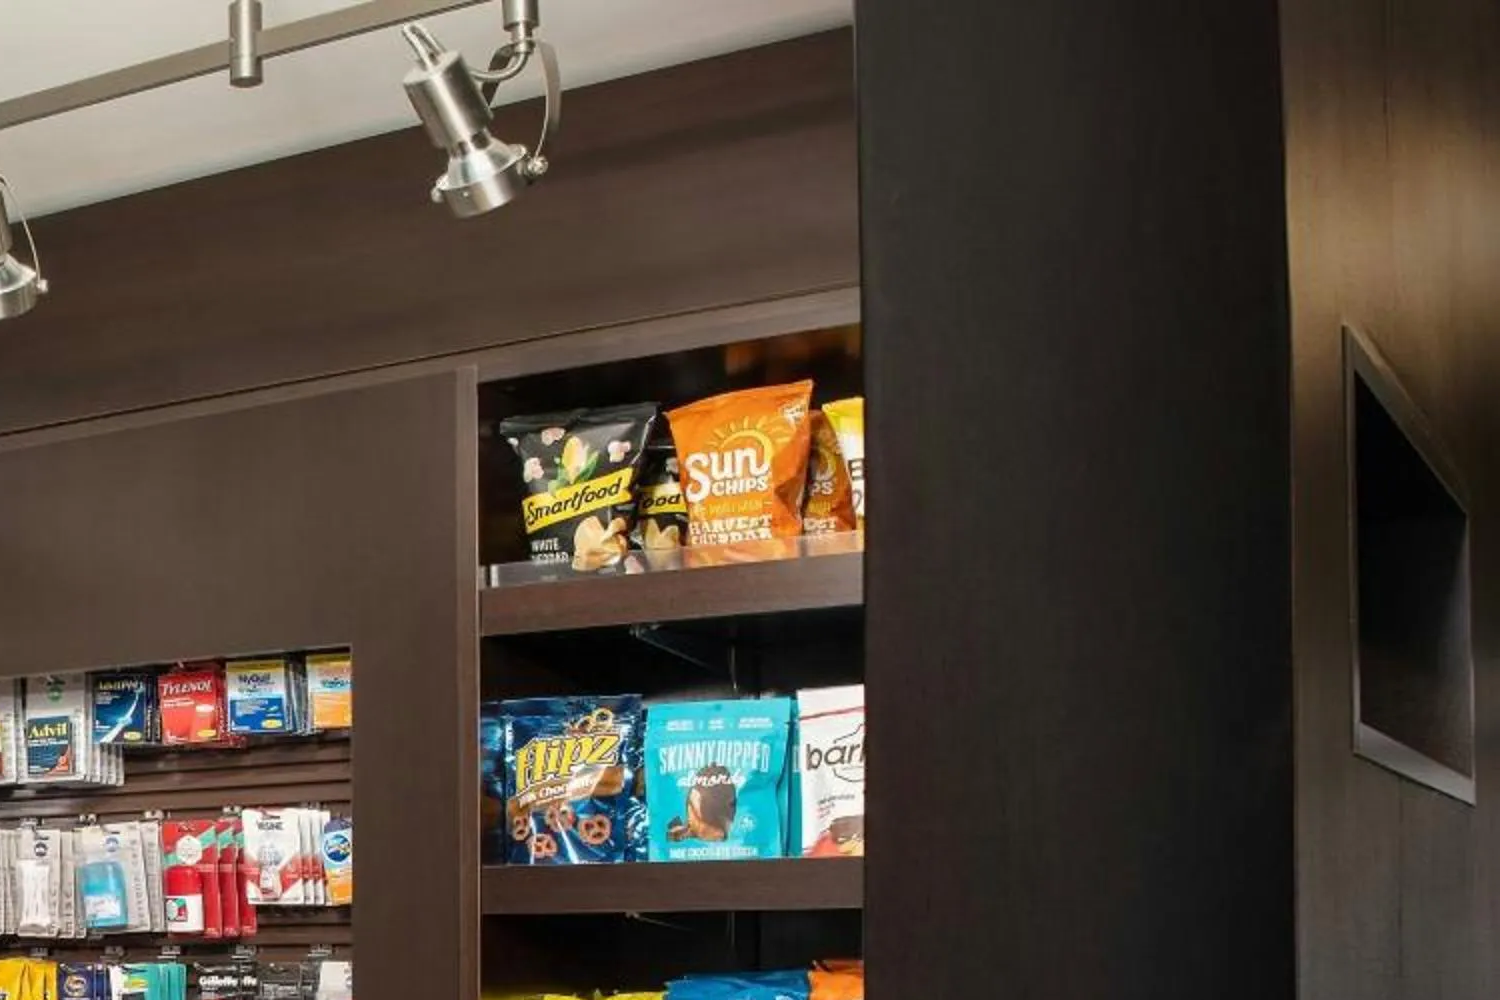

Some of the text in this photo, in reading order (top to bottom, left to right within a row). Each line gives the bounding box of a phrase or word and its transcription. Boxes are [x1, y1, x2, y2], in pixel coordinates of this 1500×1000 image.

[685, 446, 770, 503] Sun
[711, 477, 769, 496] CHIPS
[526, 476, 623, 526] Smartfood
[28, 722, 68, 738] Advil
[806, 743, 864, 771] bar
